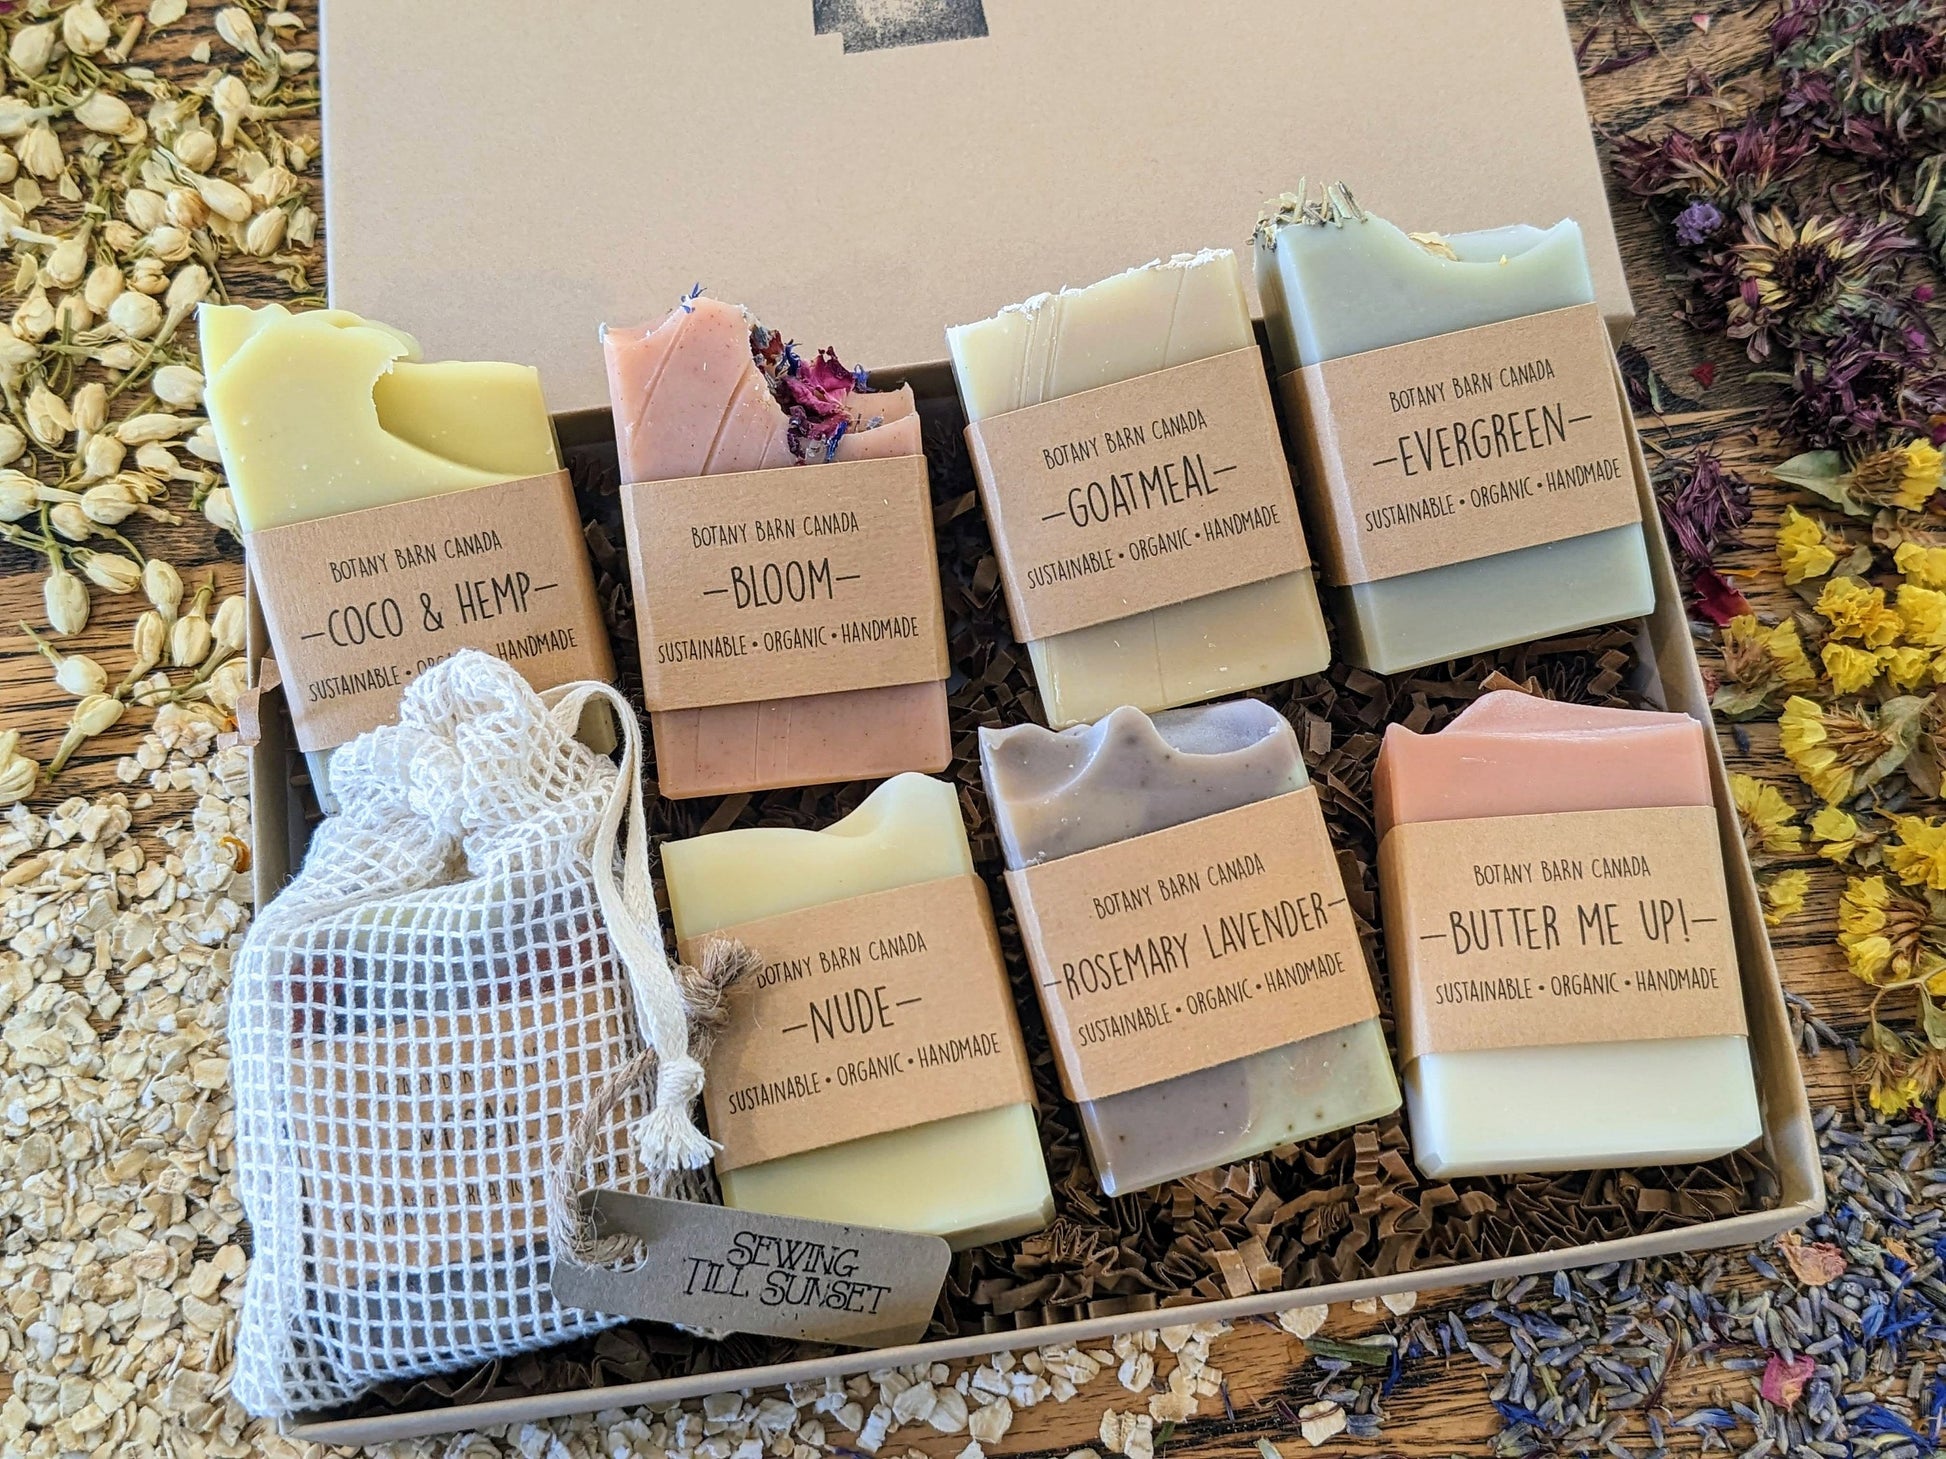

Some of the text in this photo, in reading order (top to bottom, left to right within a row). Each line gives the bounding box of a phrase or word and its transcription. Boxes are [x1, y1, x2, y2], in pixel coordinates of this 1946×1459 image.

[1388, 358, 1556, 413] BOTANY BARN CANADA
[1042, 408, 1208, 470] BOTANY BARN CANADA
[1365, 457, 1622, 533] SUSTAINABLE ORGANIC HANDMADE
[328, 529, 503, 584] BOTANY BARN CANADA
[691, 511, 860, 549] BOTANY BARN CANADA
[1027, 508, 1281, 590] SUSTAINABLE ORGANIC HANDMADE
[419, 592, 445, 633] &
[658, 616, 920, 664] SUSTAINABLE ORGANIC HANDMADE
[308, 627, 578, 703] SUSTAINABLE HANDMADE
[1092, 852, 1266, 920] BOTANY BARN CANADA
[1473, 855, 1652, 887] BOTANY BARN CANADA
[1577, 902, 1624, 946] ME
[818, 945, 862, 974] BARN
[868, 930, 928, 961] CANADA
[1078, 951, 1346, 1047] SUSTAINABLE ORGANIC HANDMADE
[1435, 966, 1720, 1005] SUSTAINABLE ORGANIC HANDMADE
[728, 1032, 1001, 1115] SUSTAINABLE ORGANIC HANDMADE
[726, 1230, 859, 1278] SEWING
[683, 1256, 892, 1315] TILL SUNSET
